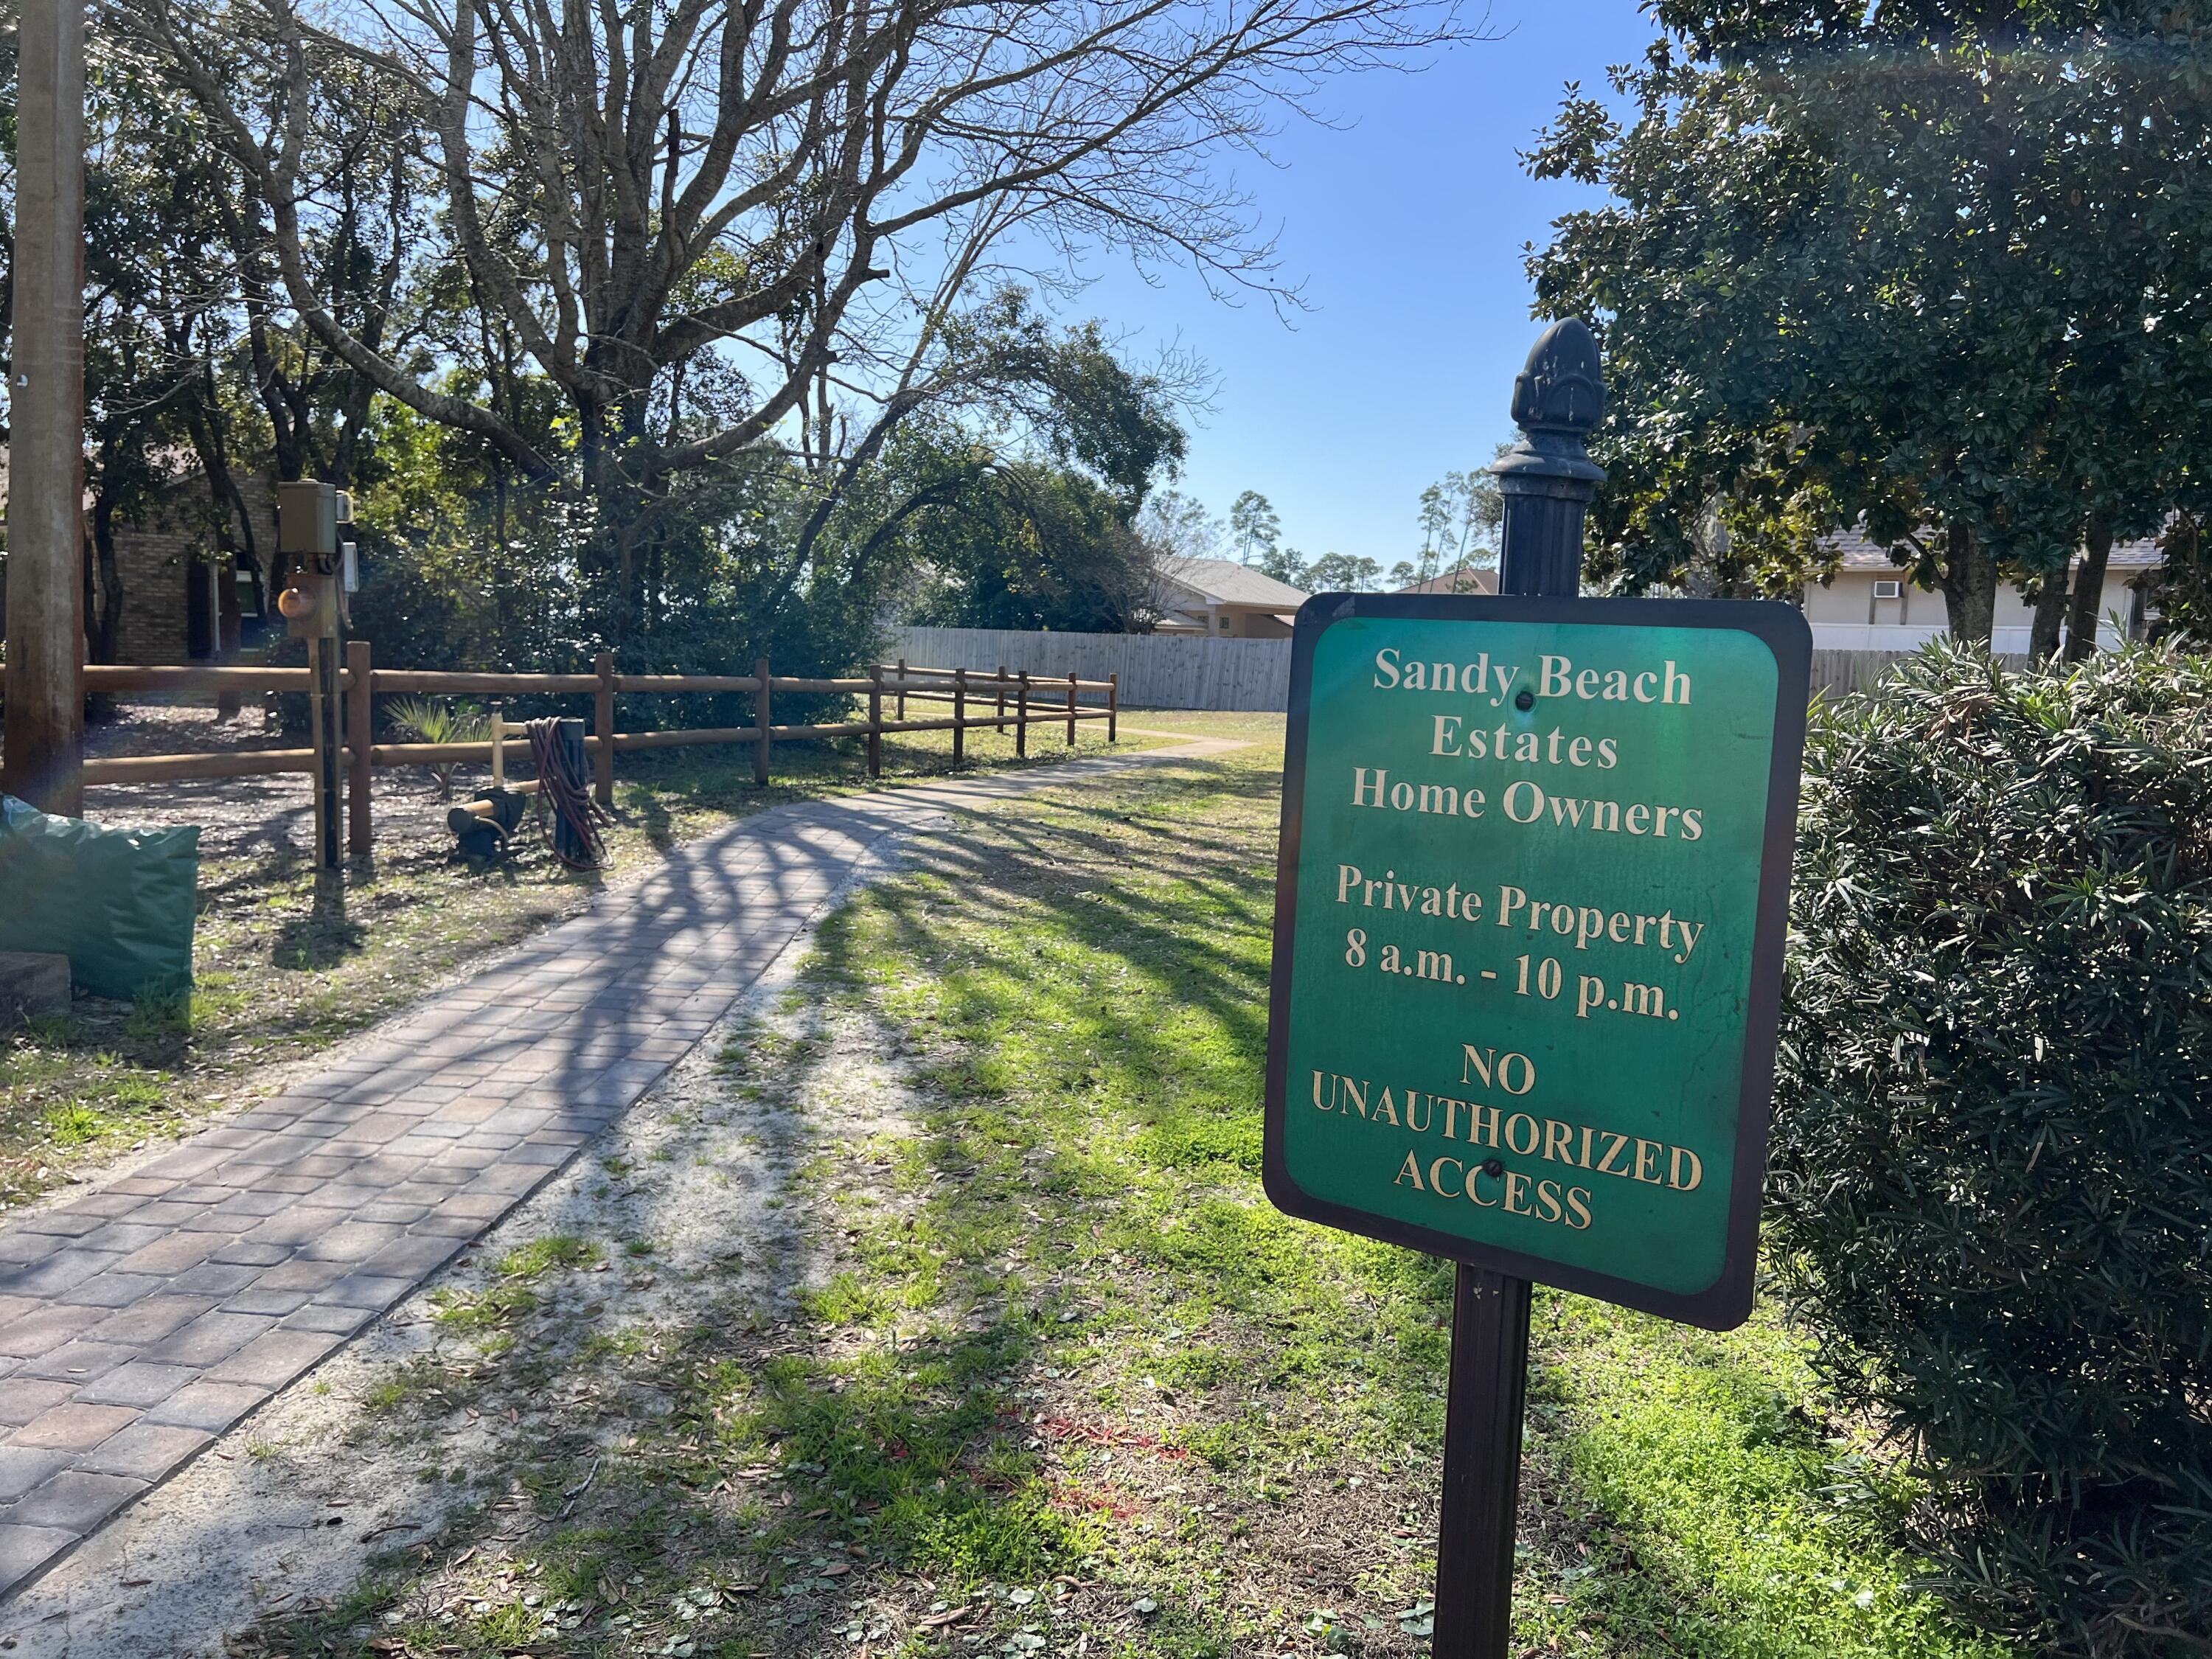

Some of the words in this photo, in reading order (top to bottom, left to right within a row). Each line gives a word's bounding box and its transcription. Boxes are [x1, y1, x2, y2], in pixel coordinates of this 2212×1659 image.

[1372, 647, 1520, 707] Sandy
[1534, 654, 1691, 705] Beach
[1429, 714, 1617, 769] Estates
[1351, 766, 1486, 818] Home
[1501, 780, 1703, 841] Owners
[1335, 863, 1482, 922] Private
[1495, 884, 1705, 964] Property
[1343, 928, 1366, 967] 8
[1379, 944, 1465, 984] a.m.
[1479, 970, 1497, 979] -
[1514, 953, 1562, 999] 10
[1575, 975, 1678, 1020] p.m.
[1458, 1043, 1535, 1094] NO
[1312, 1070, 1702, 1191] UNAUTHORIZED
[1393, 1148, 1591, 1229] ACCESS
